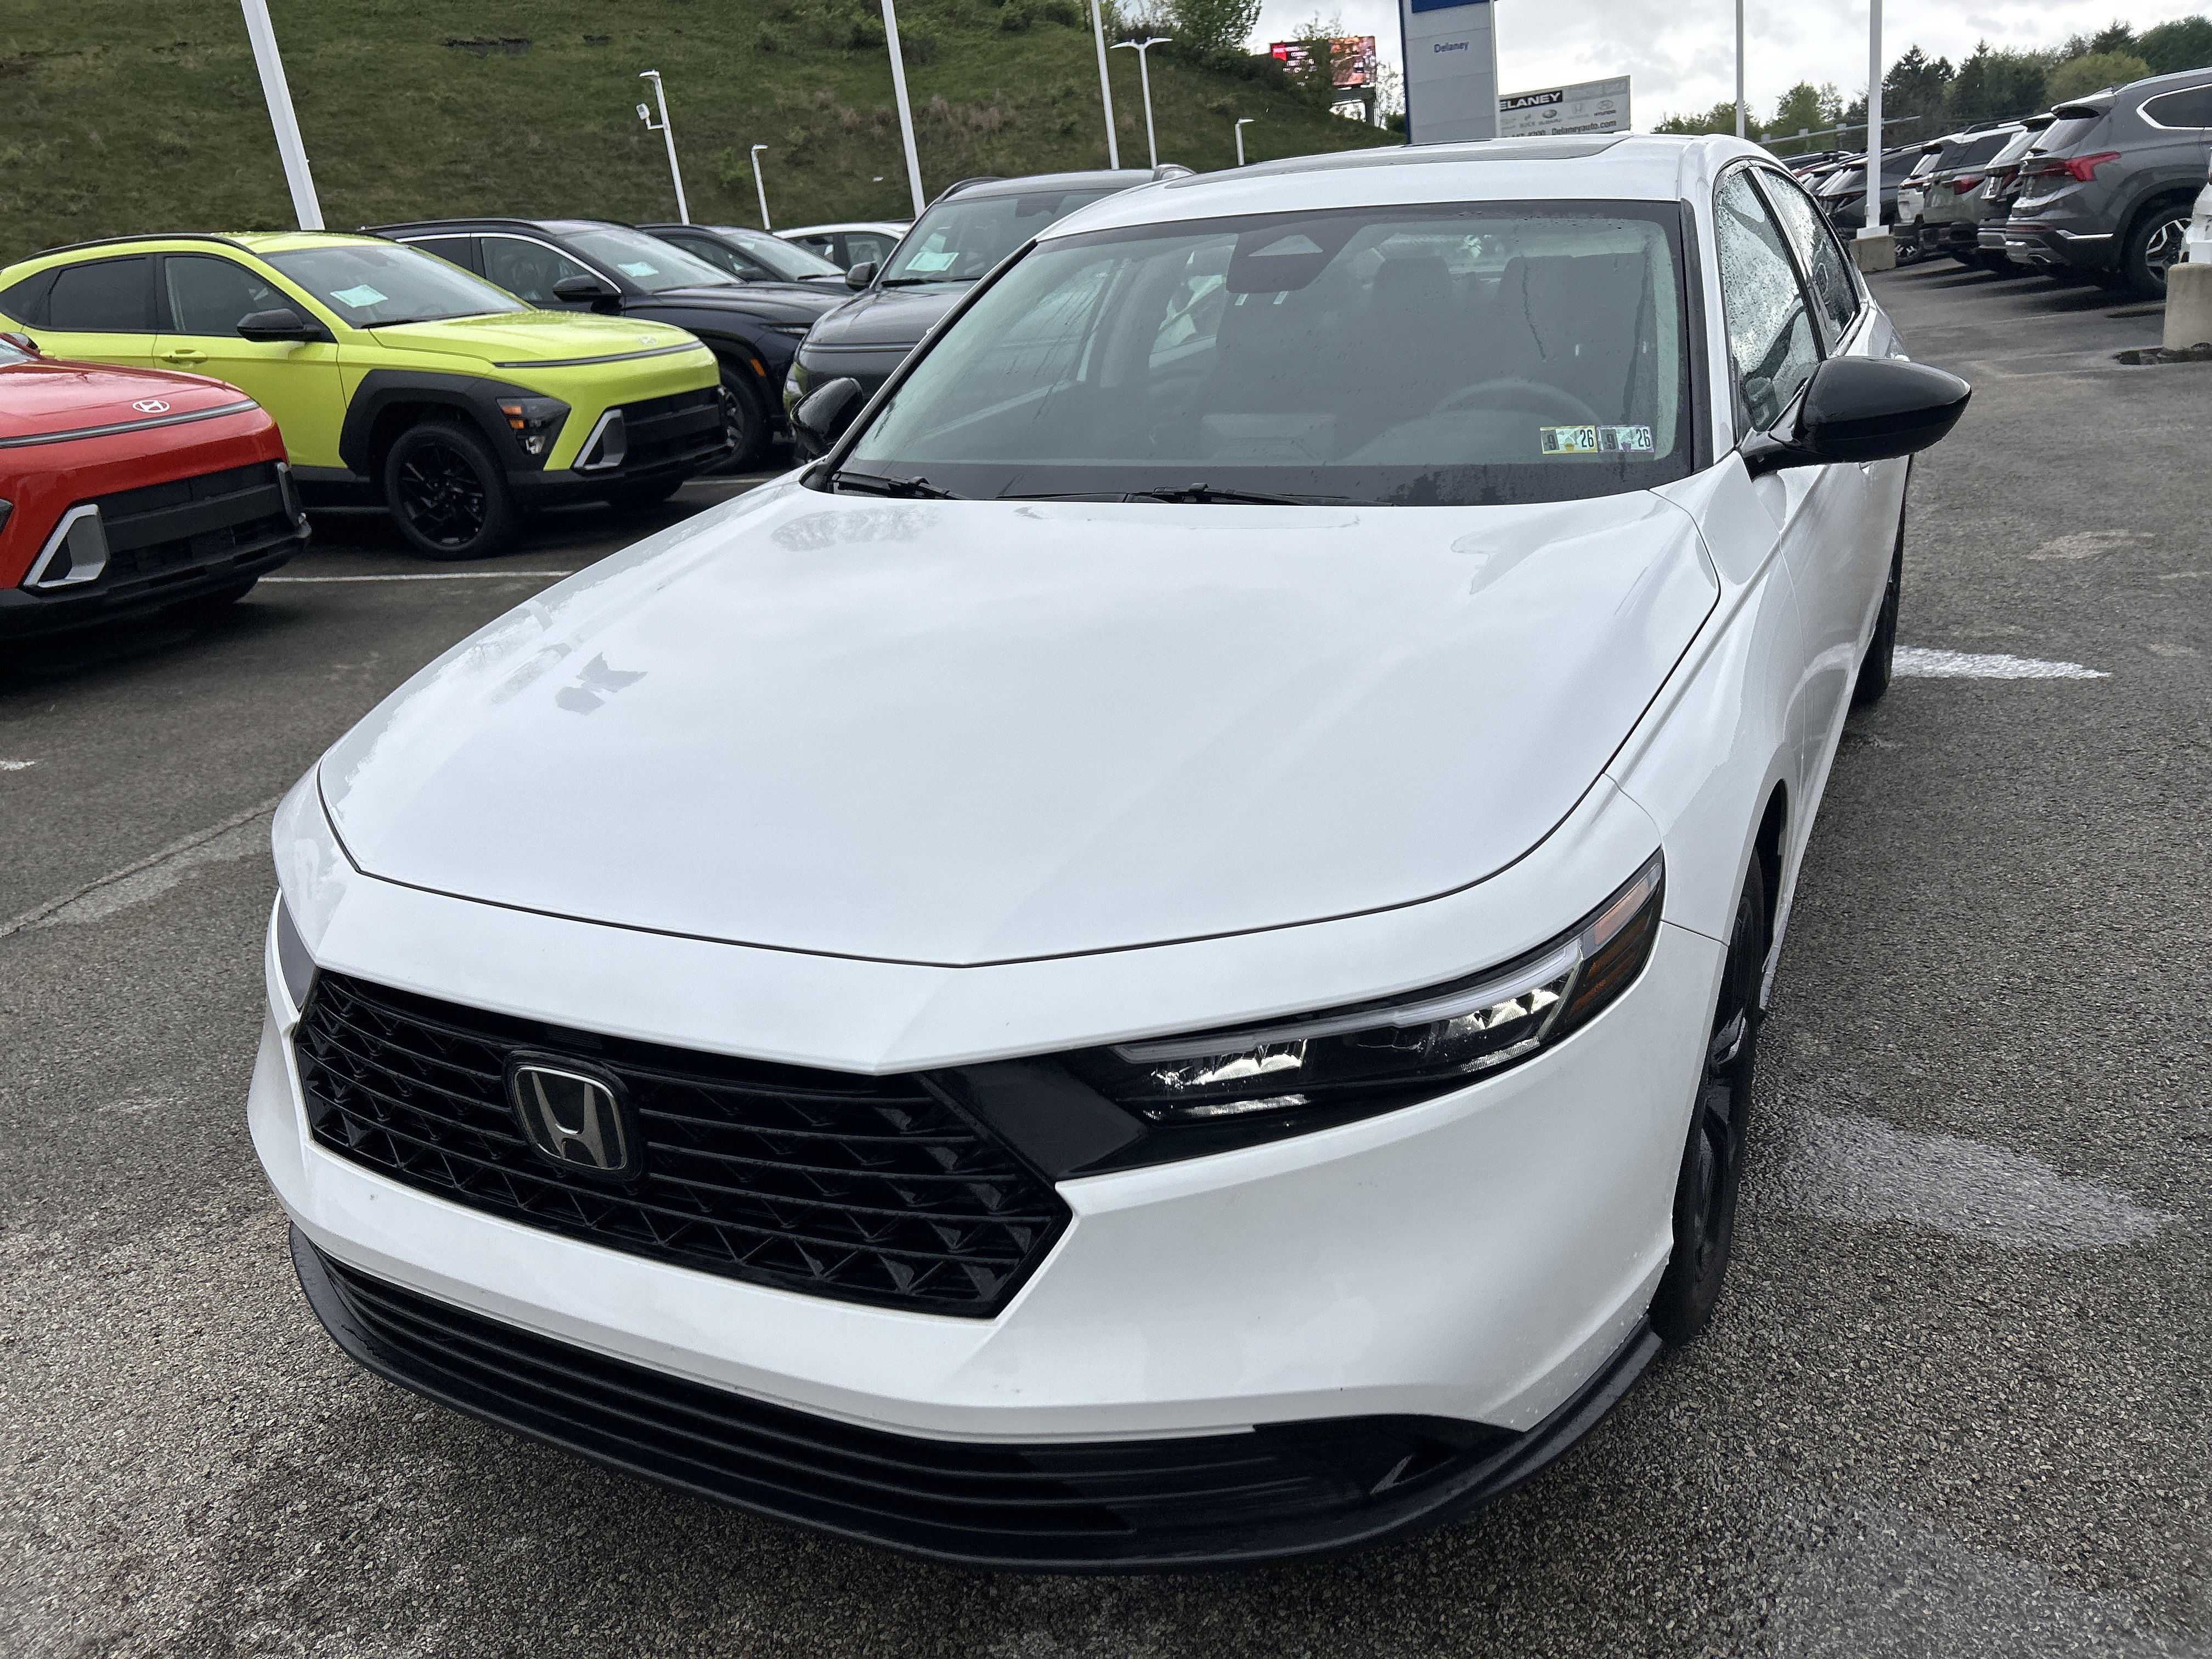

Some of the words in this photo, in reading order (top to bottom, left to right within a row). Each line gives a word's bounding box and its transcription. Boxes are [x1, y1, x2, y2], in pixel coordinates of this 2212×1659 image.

[1434, 41, 1469, 53] Delaney
[1500, 92, 1561, 110] ELANEY
[1579, 429, 1594, 448] 26
[1635, 428, 1651, 447] 26
